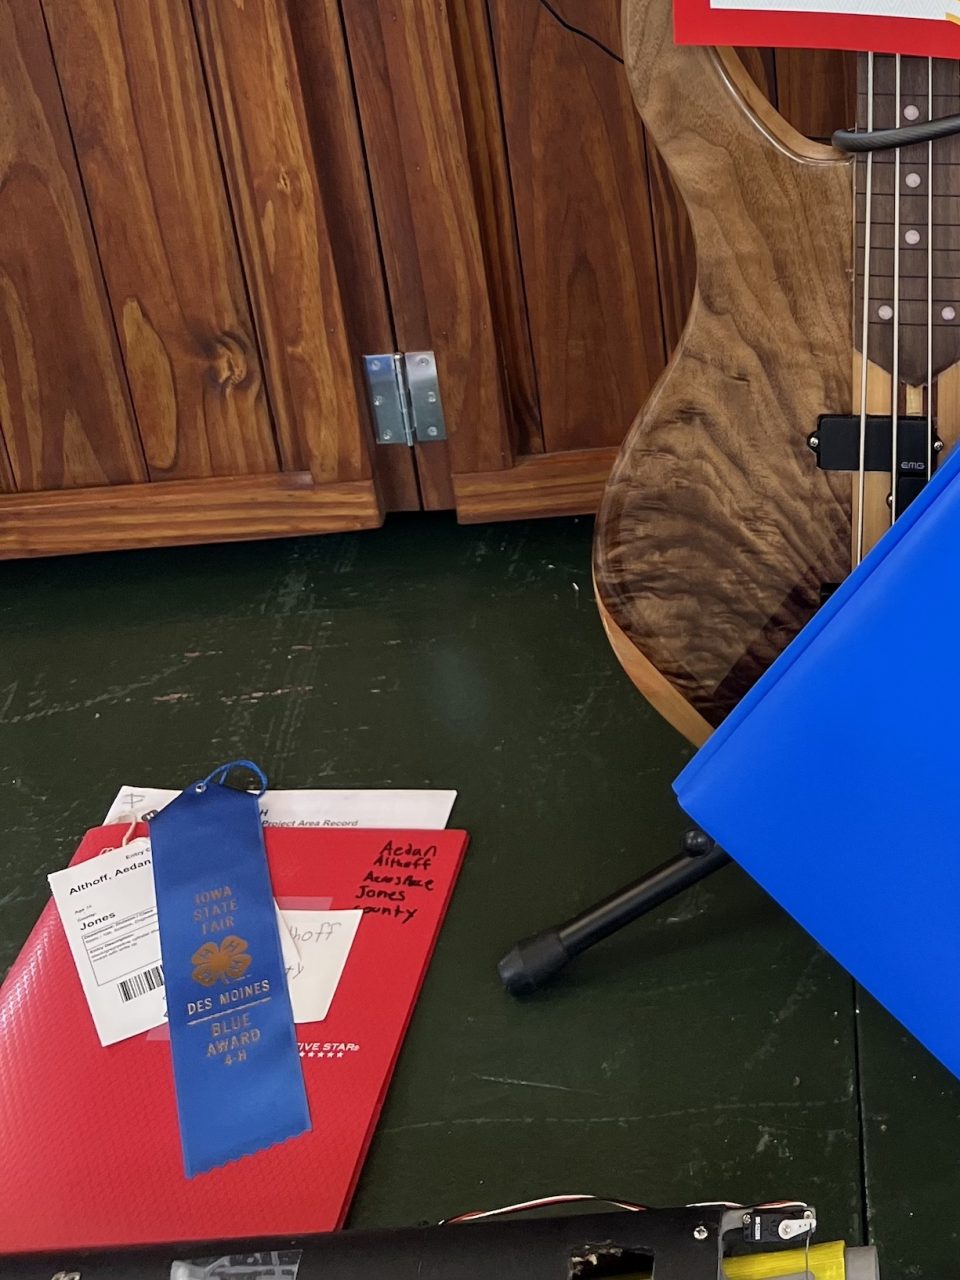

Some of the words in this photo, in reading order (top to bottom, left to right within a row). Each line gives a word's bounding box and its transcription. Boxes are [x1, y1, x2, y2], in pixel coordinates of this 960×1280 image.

[901, 461, 926, 470] EMG
[125, 849, 144, 860] Entry
[380, 840, 437, 857] Aedan
[69, 873, 112, 896] Althoff,
[115, 858, 152, 877] Aedan
[194, 885, 232, 906] IOWA
[355, 885, 406, 902] Jones
[194, 900, 239, 922] STATE
[80, 912, 116, 931] Jones
[202, 916, 235, 935] FAIR
[187, 996, 213, 1016] DES
[219, 979, 271, 1006] MOINES
[211, 1013, 252, 1037] BLUE
[206, 1028, 261, 1058] AWARD
[297, 1042, 321, 1051] IVE
[224, 1051, 248, 1067] 4-H
